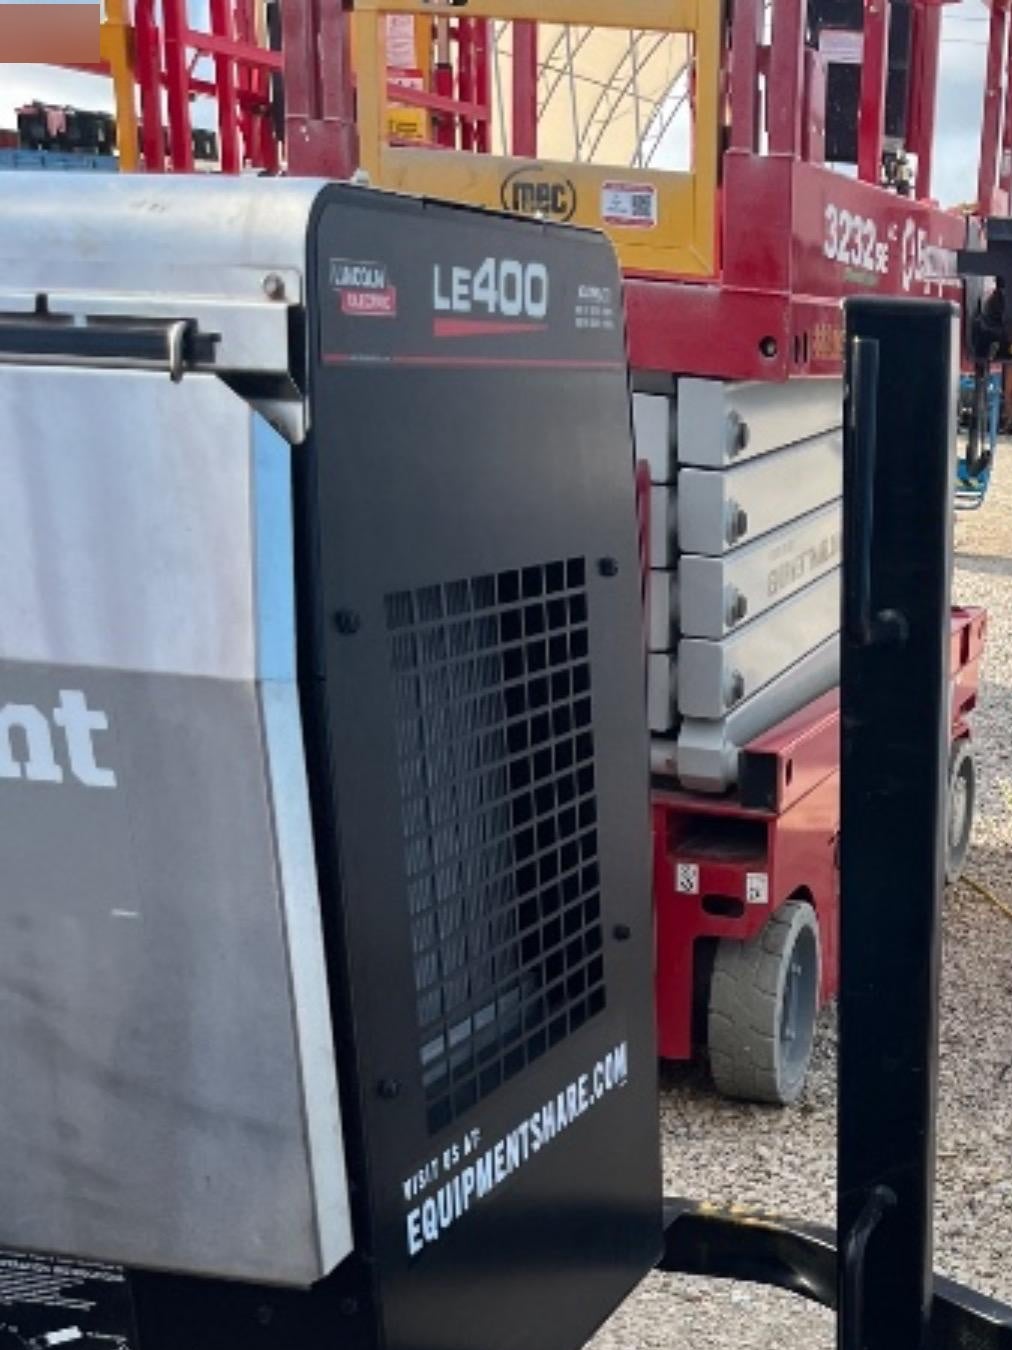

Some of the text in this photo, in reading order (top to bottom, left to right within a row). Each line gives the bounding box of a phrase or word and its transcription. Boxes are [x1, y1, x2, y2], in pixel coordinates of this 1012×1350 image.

[511, 183, 567, 213] mec
[433, 256, 548, 318] LE400
[403, 1157, 439, 1201] VISIT
[443, 1143, 460, 1171] US
[406, 1041, 629, 1256] EQUIPMENTSHARE.COM
